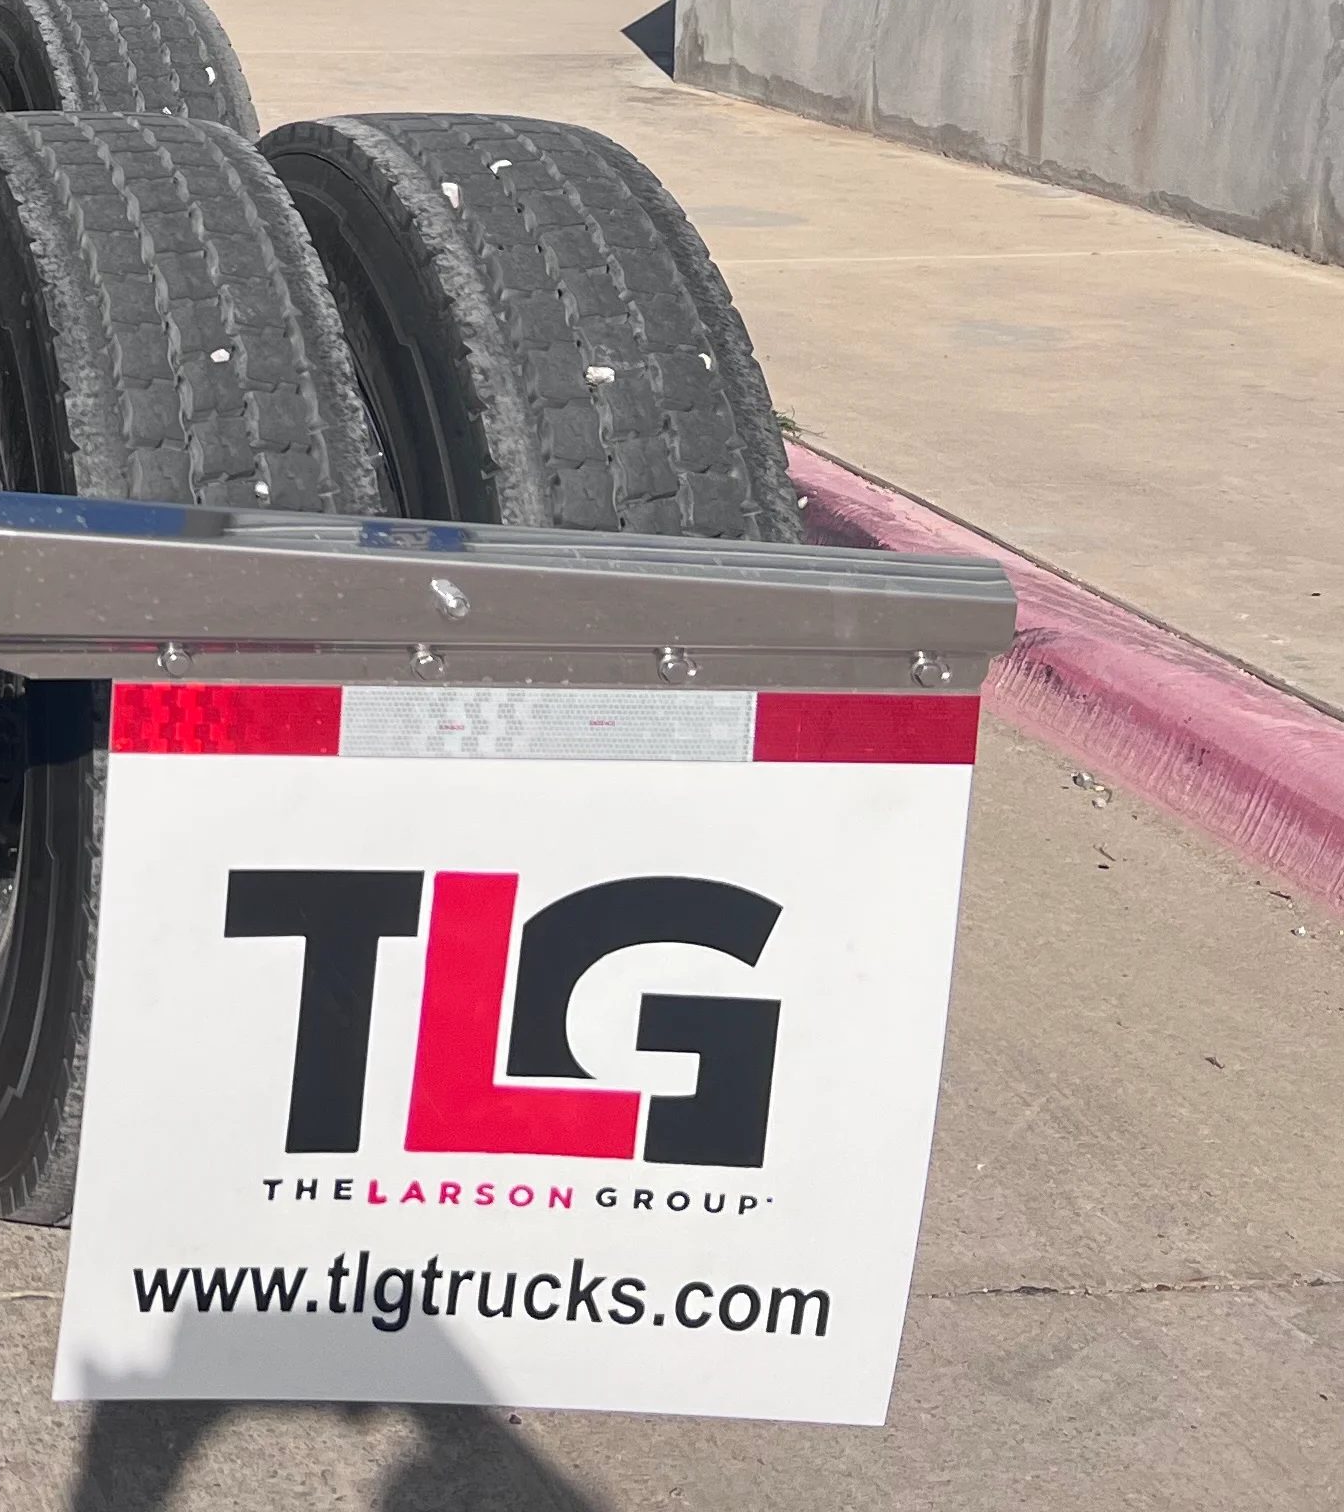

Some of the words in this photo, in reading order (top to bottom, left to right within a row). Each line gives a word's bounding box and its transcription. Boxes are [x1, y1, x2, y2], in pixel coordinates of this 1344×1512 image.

[224, 868, 783, 1169] TLG
[596, 1187, 758, 1215] GROUP
[133, 1251, 831, 1337] www.tlgtrucks.com
